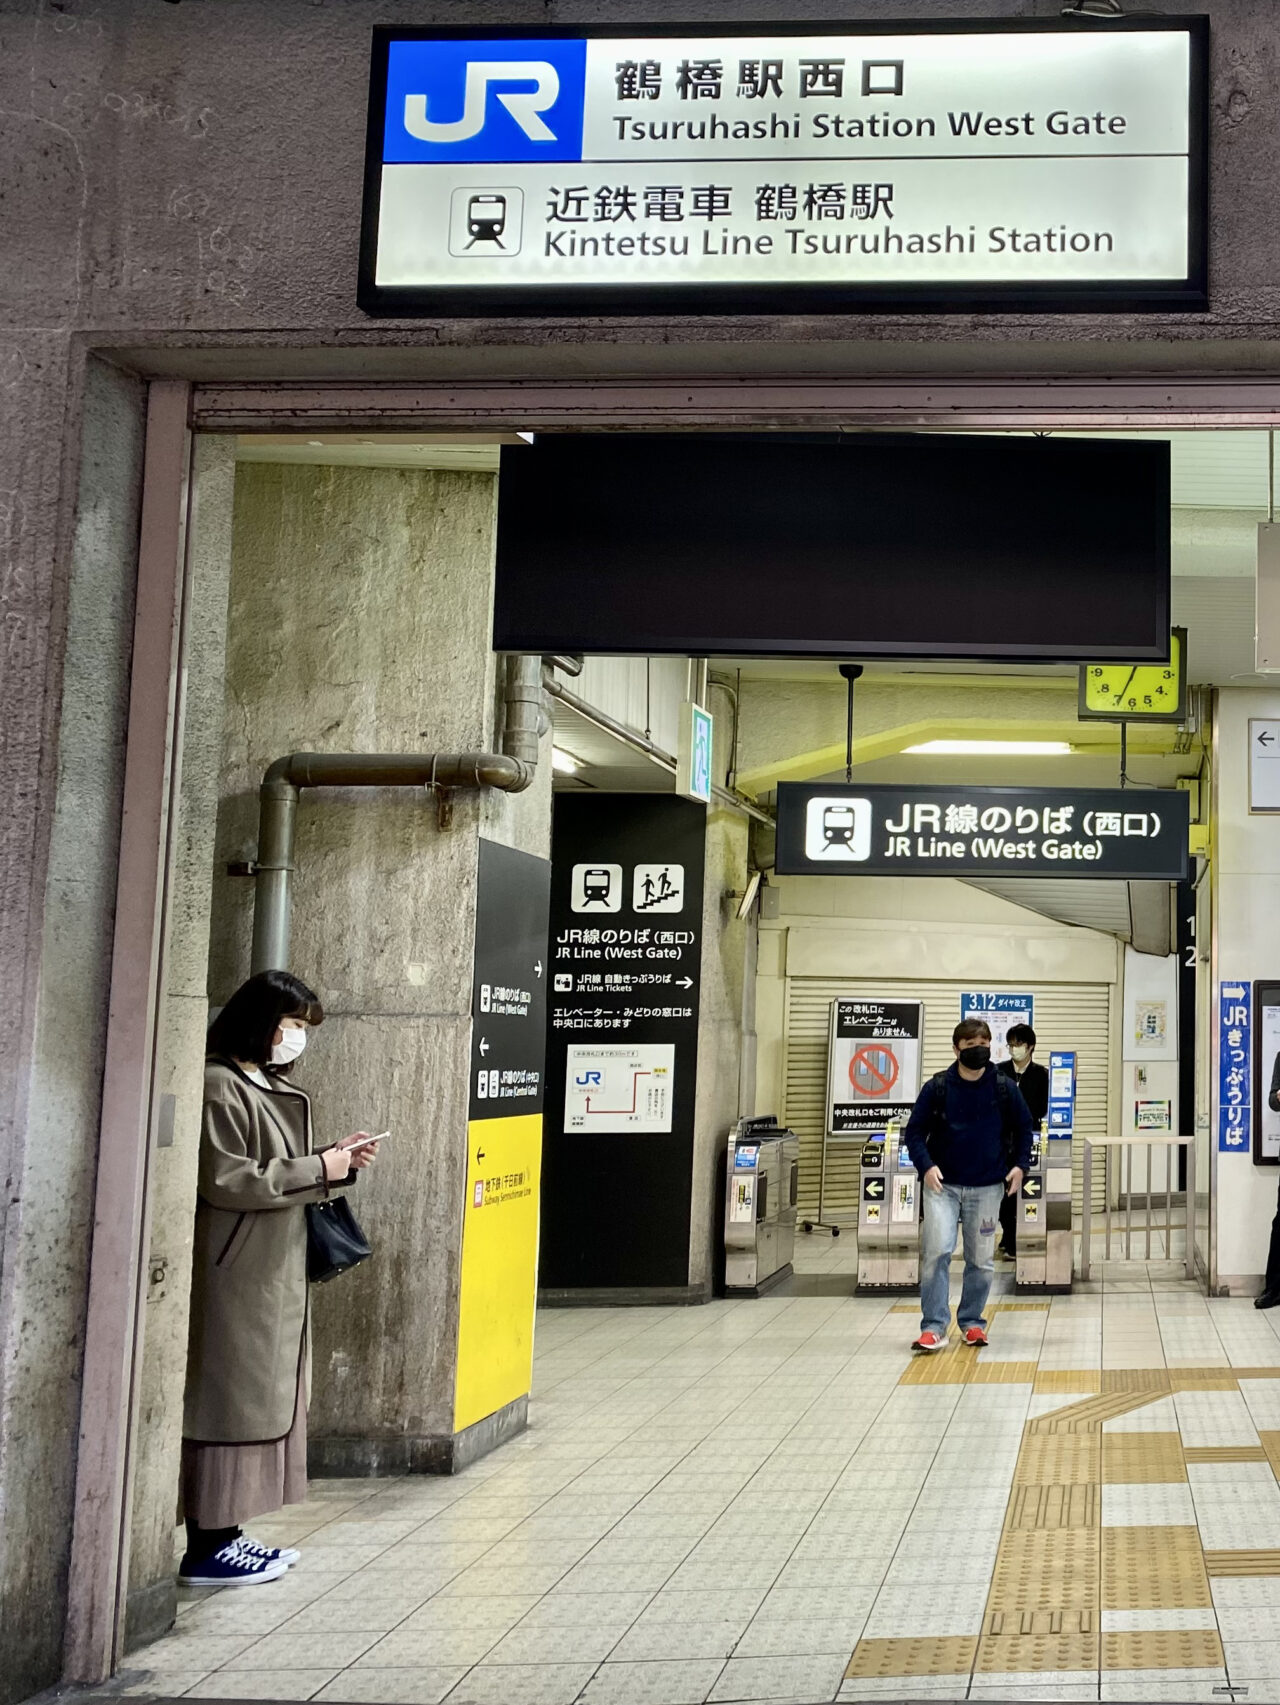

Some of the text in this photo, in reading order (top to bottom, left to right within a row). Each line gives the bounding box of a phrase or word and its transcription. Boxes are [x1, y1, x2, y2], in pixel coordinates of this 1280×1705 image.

[614, 58, 906, 101] 鶴橋駅西口
[403, 60, 560, 143] JR
[613, 110, 1127, 142] Tsuruhashi Station West Gate
[546, 182, 895, 224] 近鉄電車 鶴橋駅
[544, 226, 1114, 258] Kintetsu Line Tsuruhashi Station
[1094, 668, 1103, 677] 9
[1163, 670, 1171, 679] 3
[1101, 684, 1109, 693] 8
[1155, 685, 1164, 694] 4
[1128, 698, 1136, 707] 6
[1143, 695, 1152, 704] 5
[885, 838, 1102, 860] JR Line (West Gate)
[556, 947, 682, 960] JR Line (West Gate)
[1185, 946, 1196, 967] 2
[577, 974, 601, 984] JR線
[576, 984, 632, 992] JR Line Tickets
[969, 993, 1027, 1010] 3.12 ダイヤ改正
[553, 1008, 692, 1018] エレベーター・みどりの窓口は
[553, 1018, 632, 1029] 中央口にあります
[843, 1016, 897, 1026] エレベーターは
[576, 1071, 601, 1085] JR
